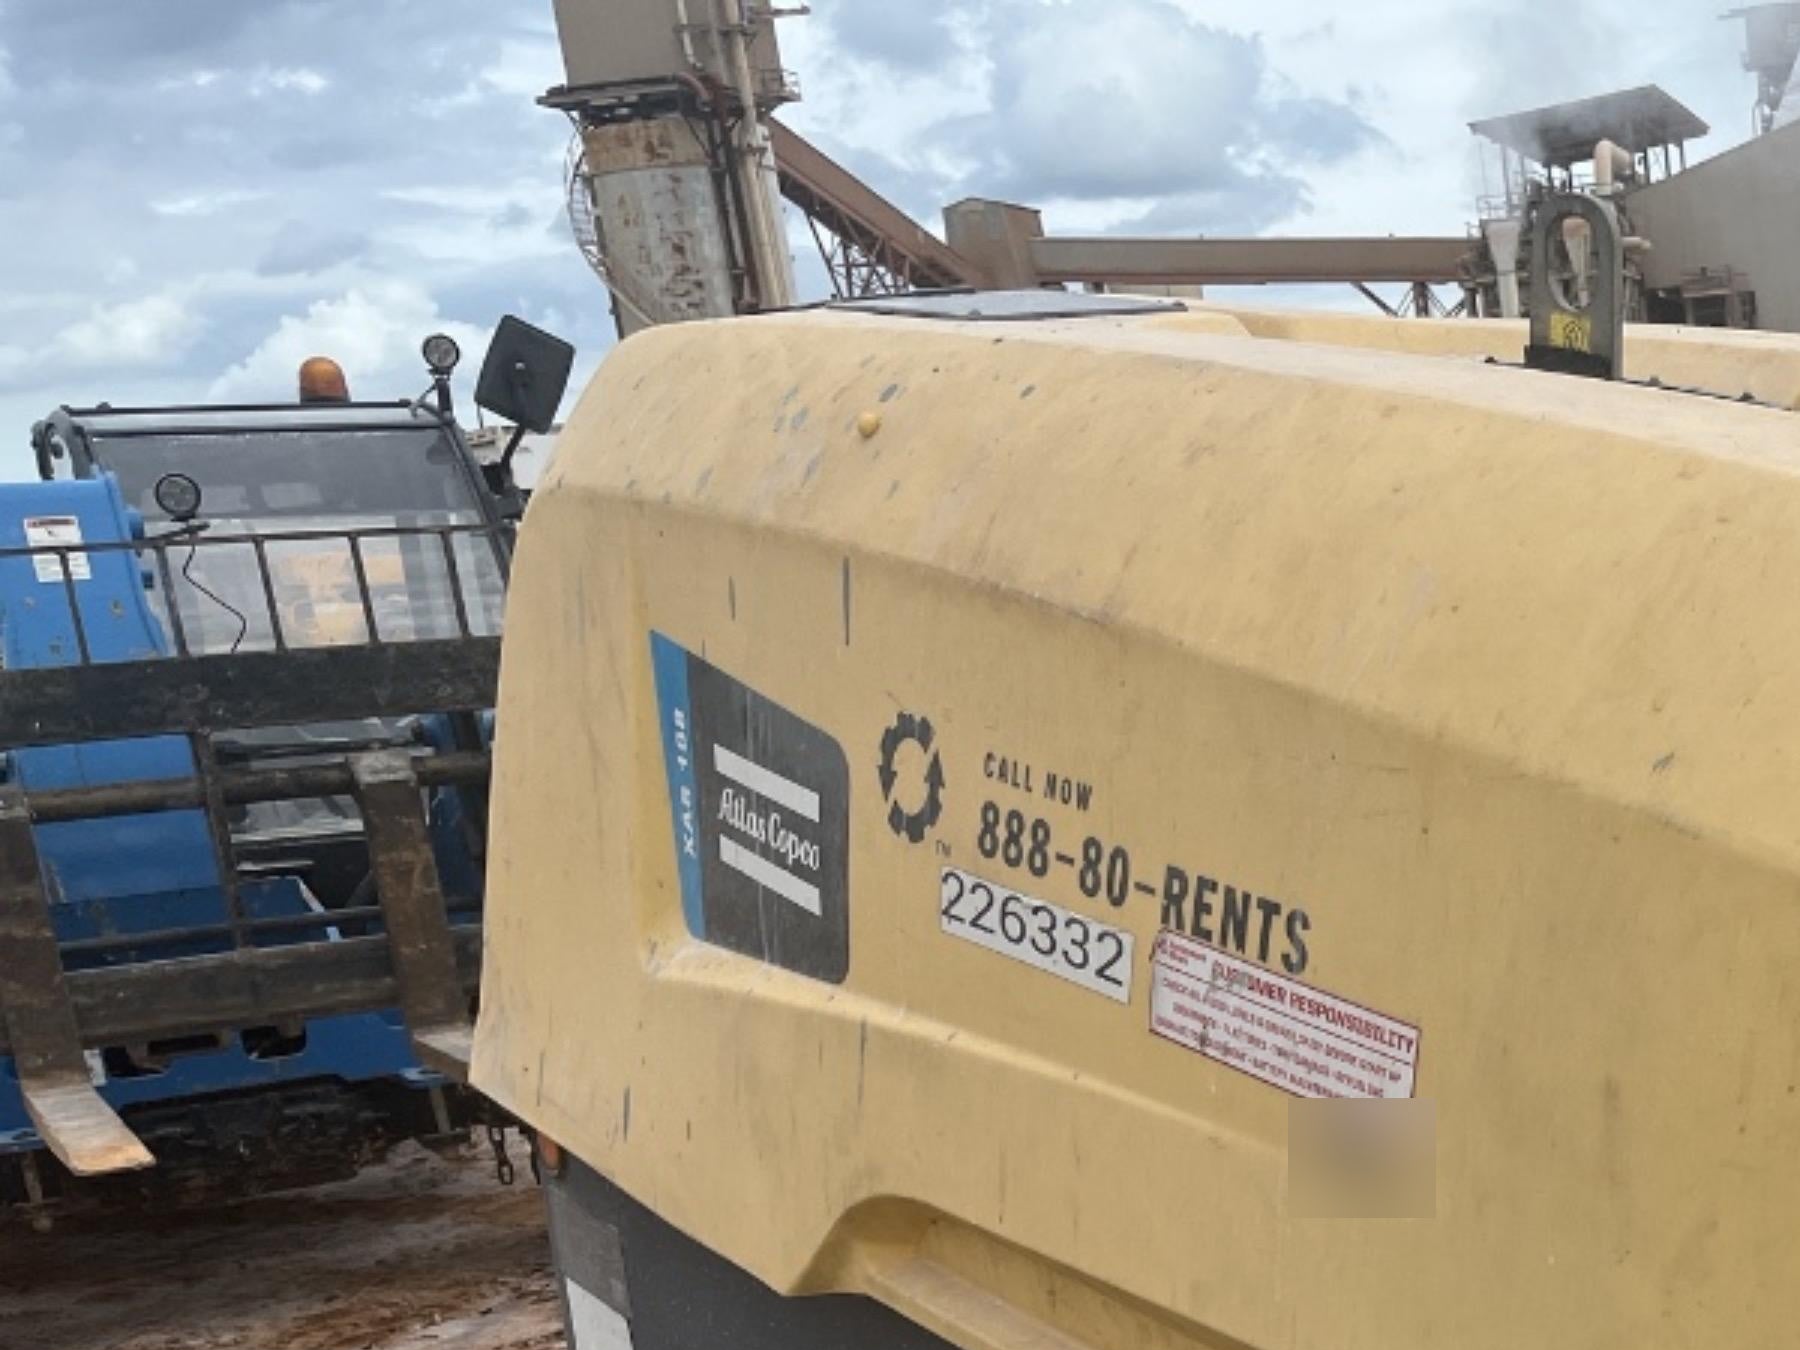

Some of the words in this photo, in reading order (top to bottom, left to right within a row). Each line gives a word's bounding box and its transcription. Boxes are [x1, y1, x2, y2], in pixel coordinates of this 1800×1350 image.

[984, 752, 1033, 793] CALL
[1044, 772, 1093, 812] NOW
[718, 788, 766, 844] Atlas
[769, 812, 820, 871] Copco
[977, 800, 1312, 975] 888-80-RENTS
[941, 871, 1125, 988] 226332
[1289, 993, 1415, 1055] RESPONSIBILITY
